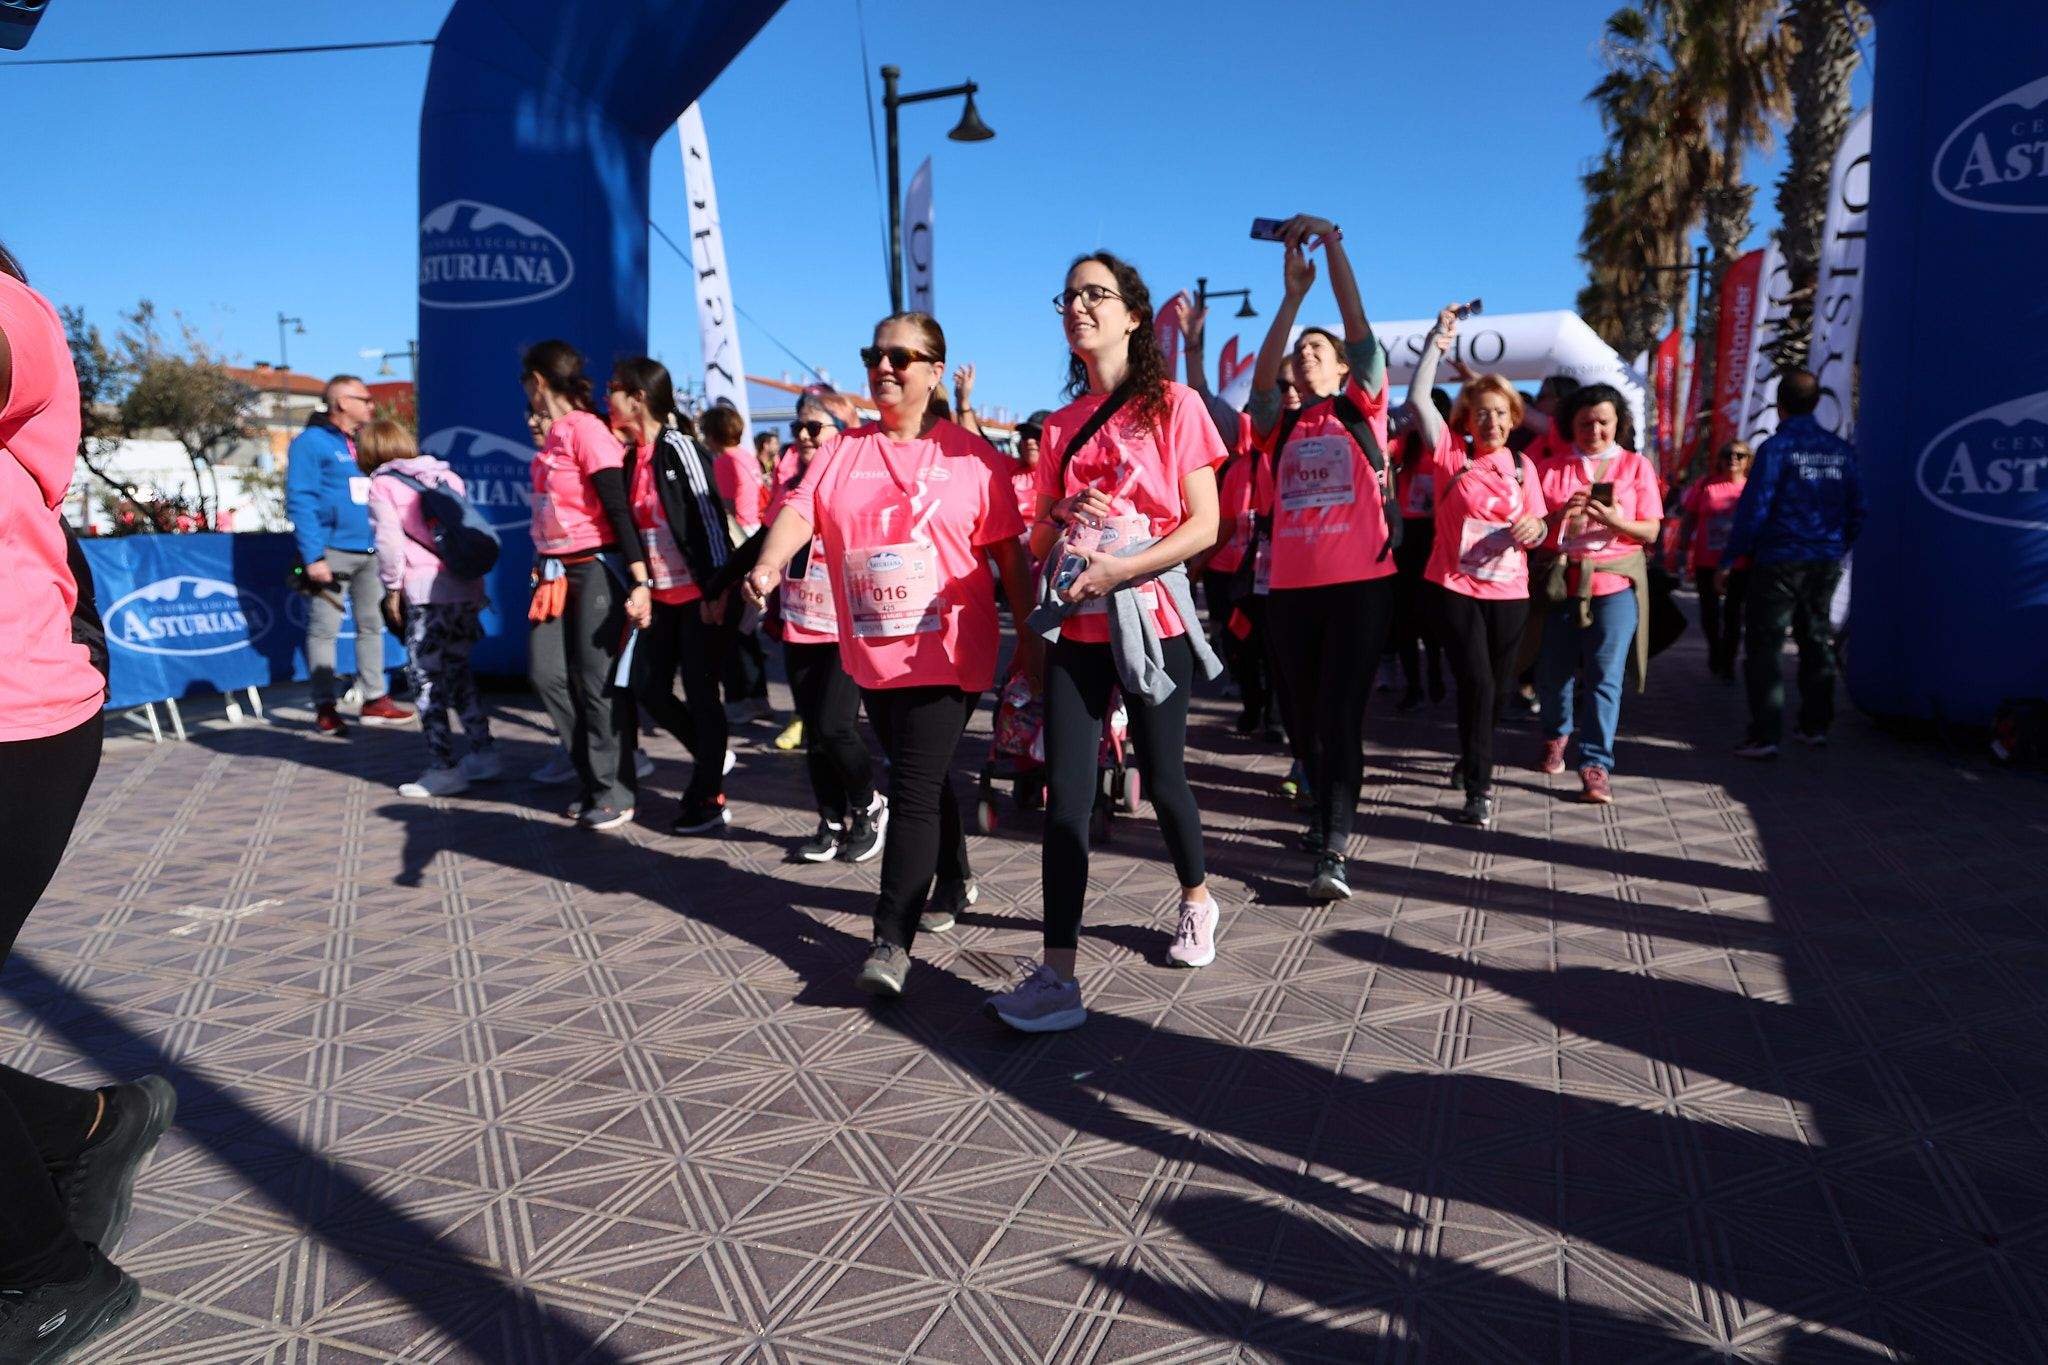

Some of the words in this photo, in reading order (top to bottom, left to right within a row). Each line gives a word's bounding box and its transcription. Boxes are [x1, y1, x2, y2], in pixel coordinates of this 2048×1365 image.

[1954, 131, 2048, 190] AST
[420, 253, 556, 285] STURIANA
[1725, 286, 1750, 394] Santander
[1300, 467, 1330, 481] 016
[1937, 441, 2048, 494] AST
[799, 589, 824, 604] 016
[873, 585, 908, 602] 016
